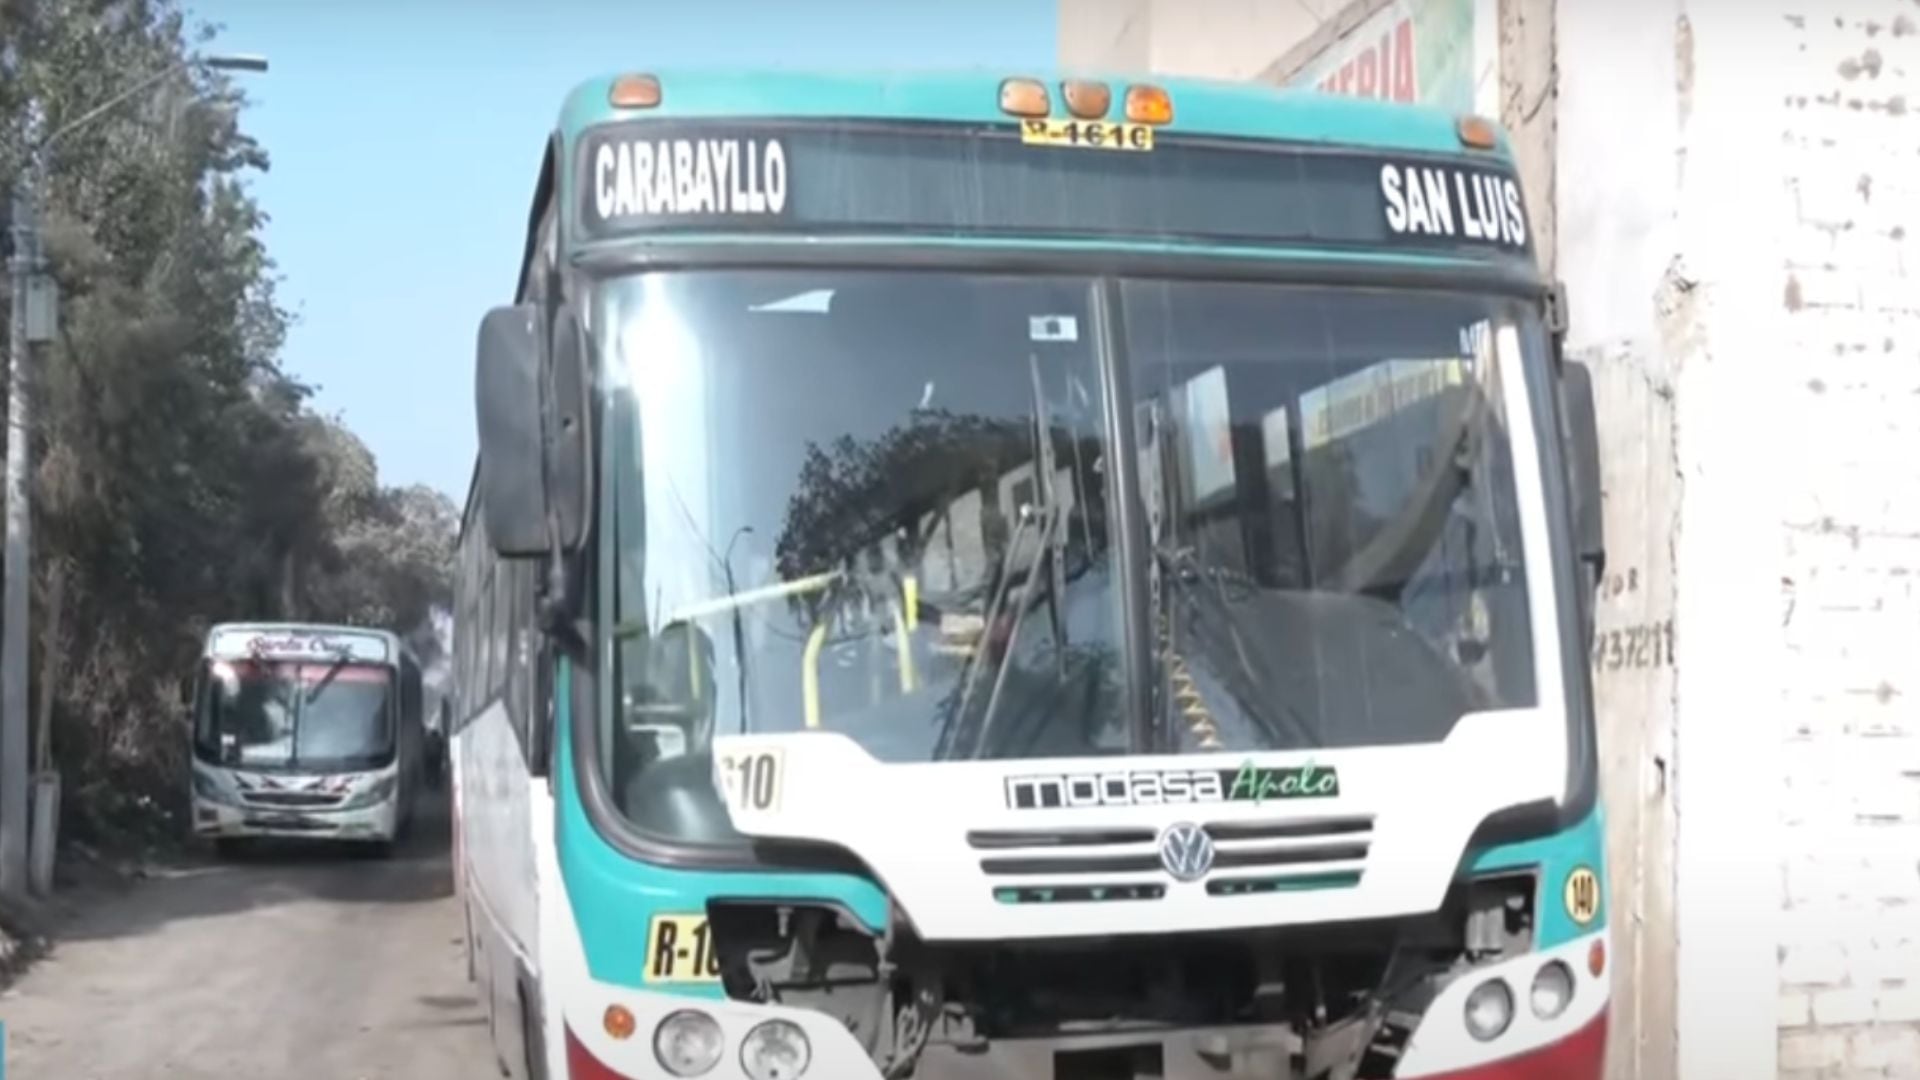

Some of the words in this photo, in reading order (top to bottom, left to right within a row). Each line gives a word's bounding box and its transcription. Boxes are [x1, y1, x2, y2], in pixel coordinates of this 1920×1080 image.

[595, 138, 787, 220] CARABAYLLO
[1380, 163, 1455, 236] SAN
[1454, 170, 1526, 247] LUIS
[1006, 770, 1223, 808] modasa
[1229, 758, 1338, 806] Apolo
[1572, 874, 1594, 916] 140
